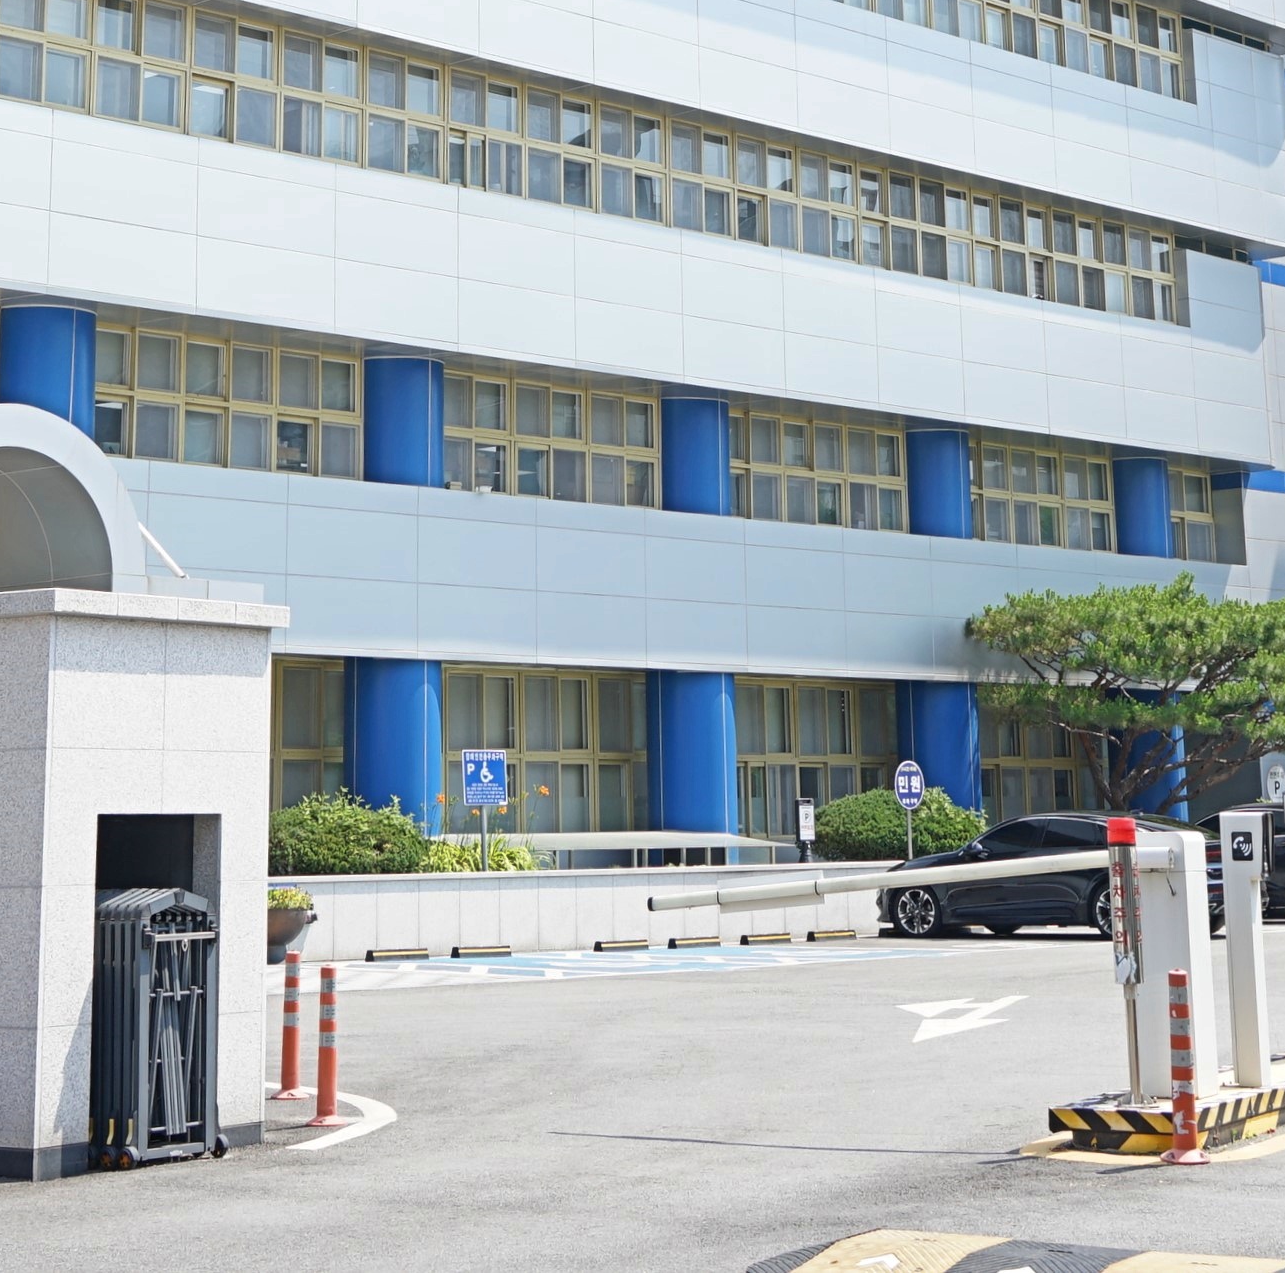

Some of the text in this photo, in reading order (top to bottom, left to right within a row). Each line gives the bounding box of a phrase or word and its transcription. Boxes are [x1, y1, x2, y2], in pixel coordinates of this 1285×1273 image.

[467, 763, 476, 776] P
[897, 775, 921, 794] 민원
[1274, 780, 1281, 795] P
